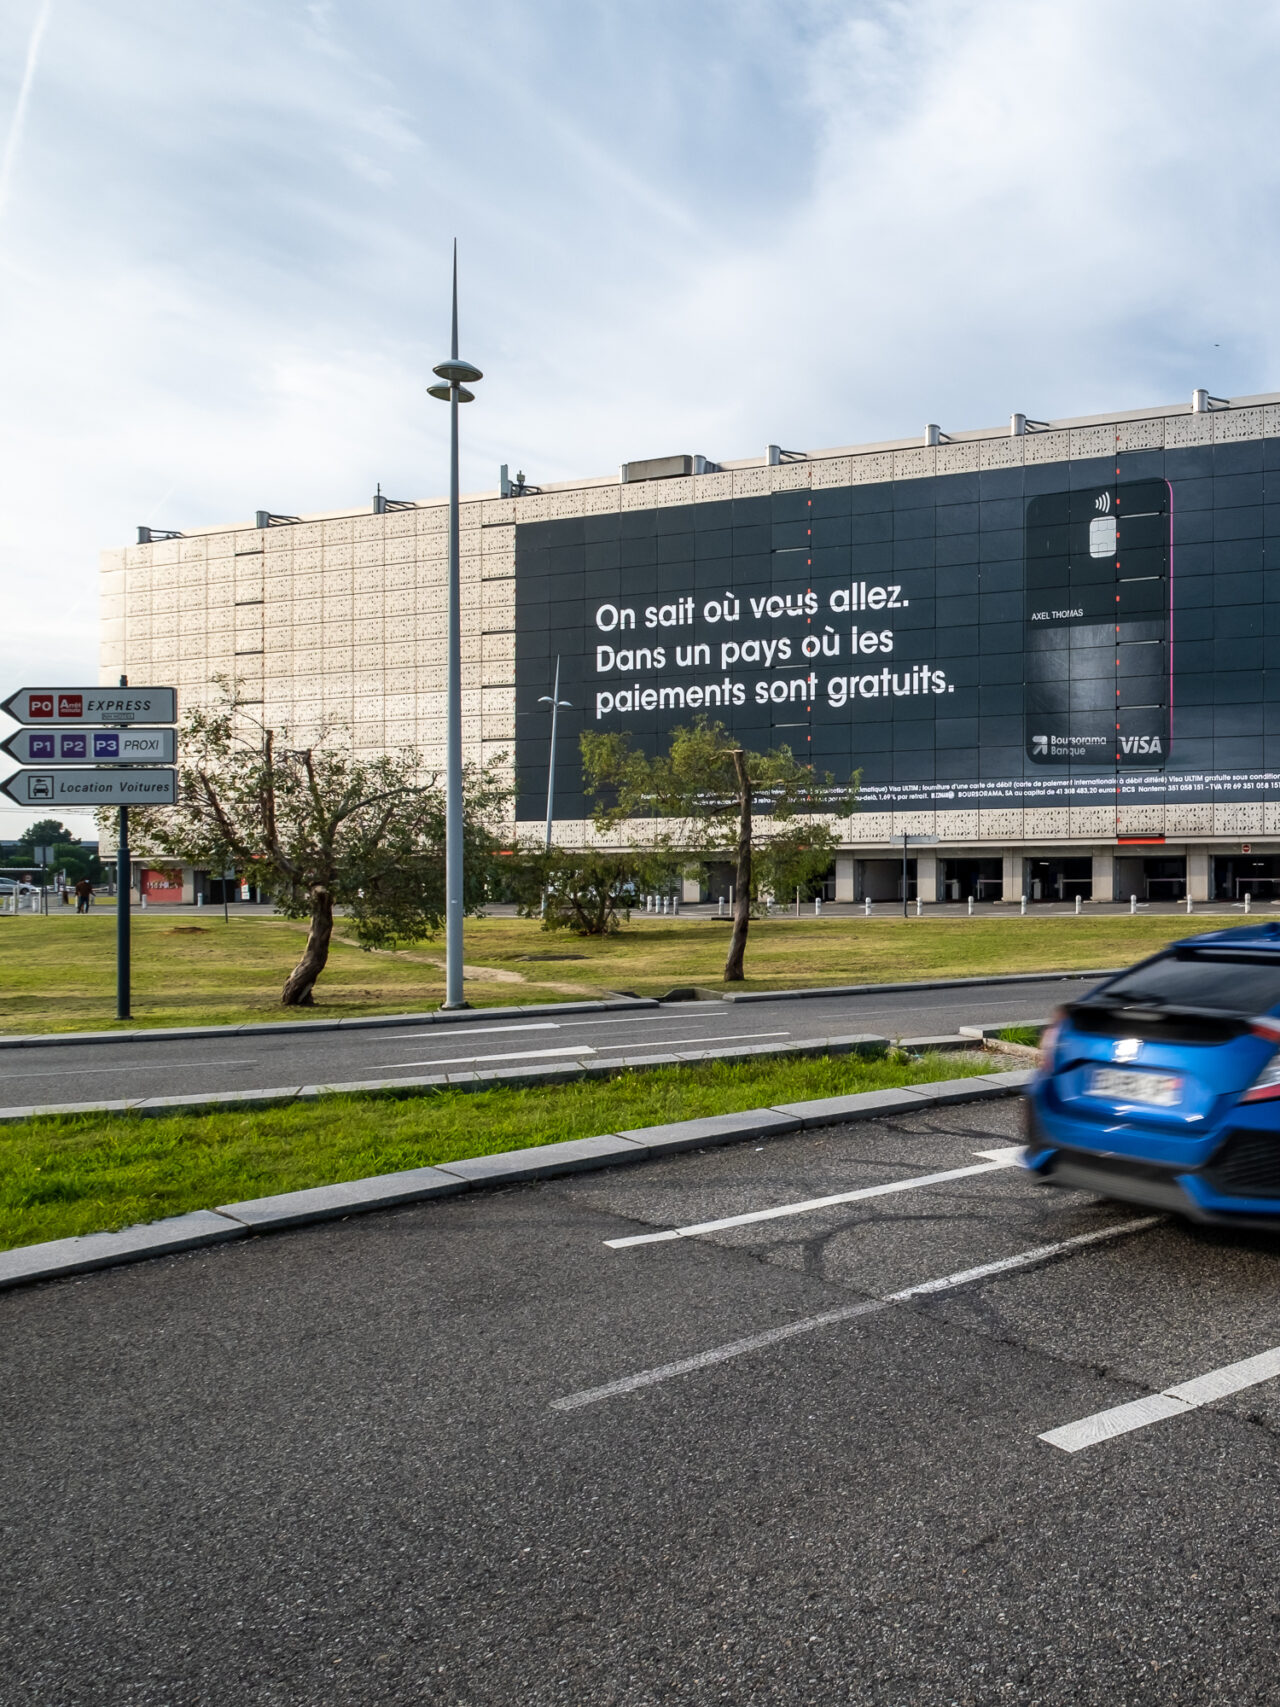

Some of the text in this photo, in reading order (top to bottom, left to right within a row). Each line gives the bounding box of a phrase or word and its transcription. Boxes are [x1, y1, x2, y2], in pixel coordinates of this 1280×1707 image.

[596, 582, 908, 631] On sait où vous allez.
[1032, 609, 1083, 620] AXEL THOMAS
[597, 626, 893, 672] Dans un pays où les
[597, 665, 954, 719] paiements sont gratuits.
[88, 700, 151, 710] EXPRESS
[96, 741, 116, 750] P3
[124, 740, 159, 750] PROXI
[1051, 736, 1106, 745] Boursorama
[1119, 736, 1162, 754] VISA
[33, 742, 50, 751] P1
[64, 741, 83, 751] P2
[1051, 745, 1086, 756] Banque
[60, 782, 169, 792] Location Voitures
[951, 782, 968, 790] d'une
[1013, 780, 1032, 789] (carte
[1168, 775, 1183, 783] Visa
[1205, 774, 1231, 782] gratuite
[1023, 789, 1045, 797] capital
